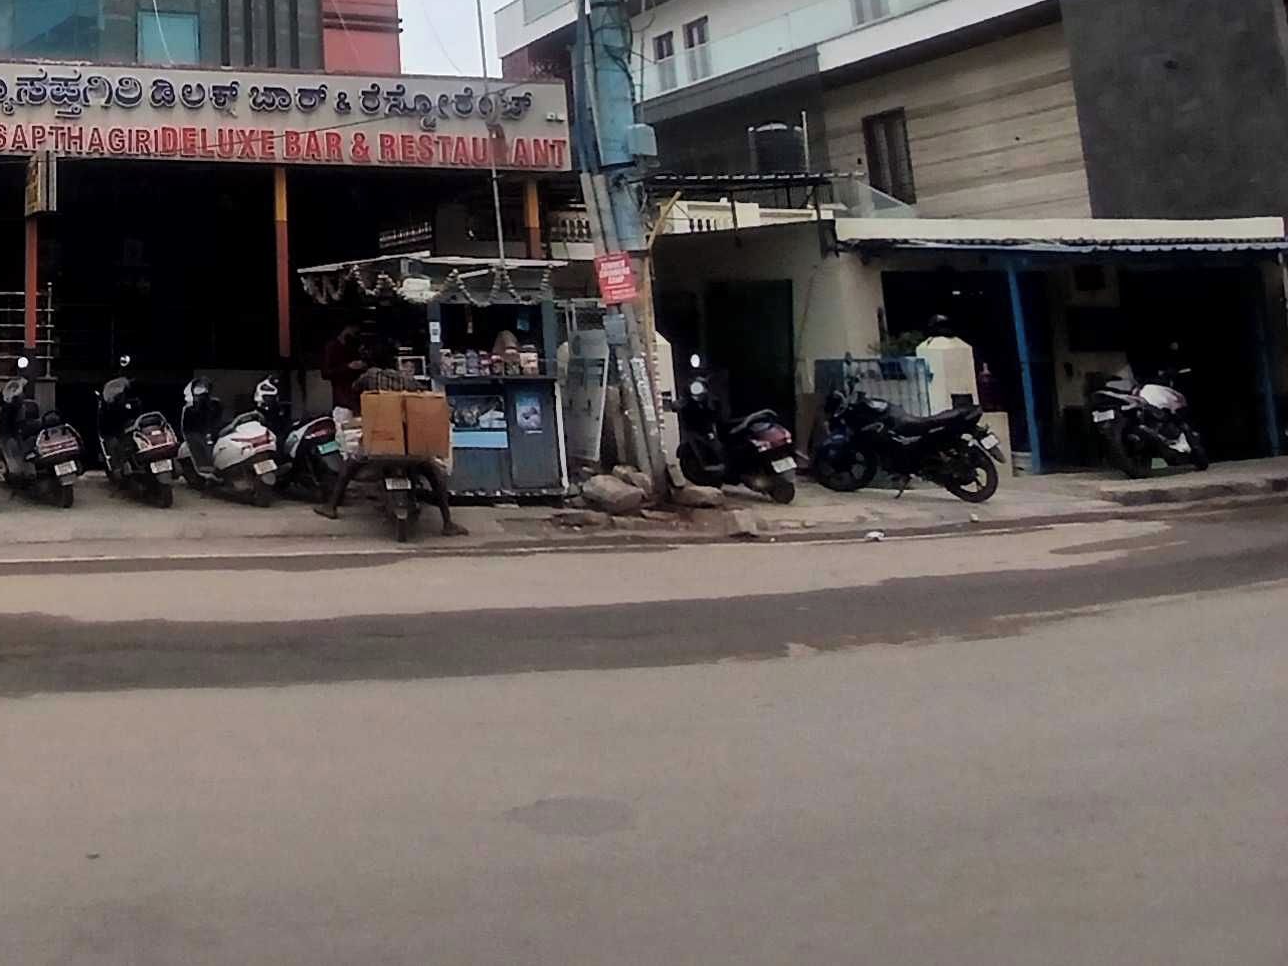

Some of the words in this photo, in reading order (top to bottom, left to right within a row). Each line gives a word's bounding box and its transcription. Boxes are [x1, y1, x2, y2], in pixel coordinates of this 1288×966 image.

[283, 130, 346, 164] BAR
[350, 131, 372, 164] &
[376, 132, 567, 168] RESTAUANT
